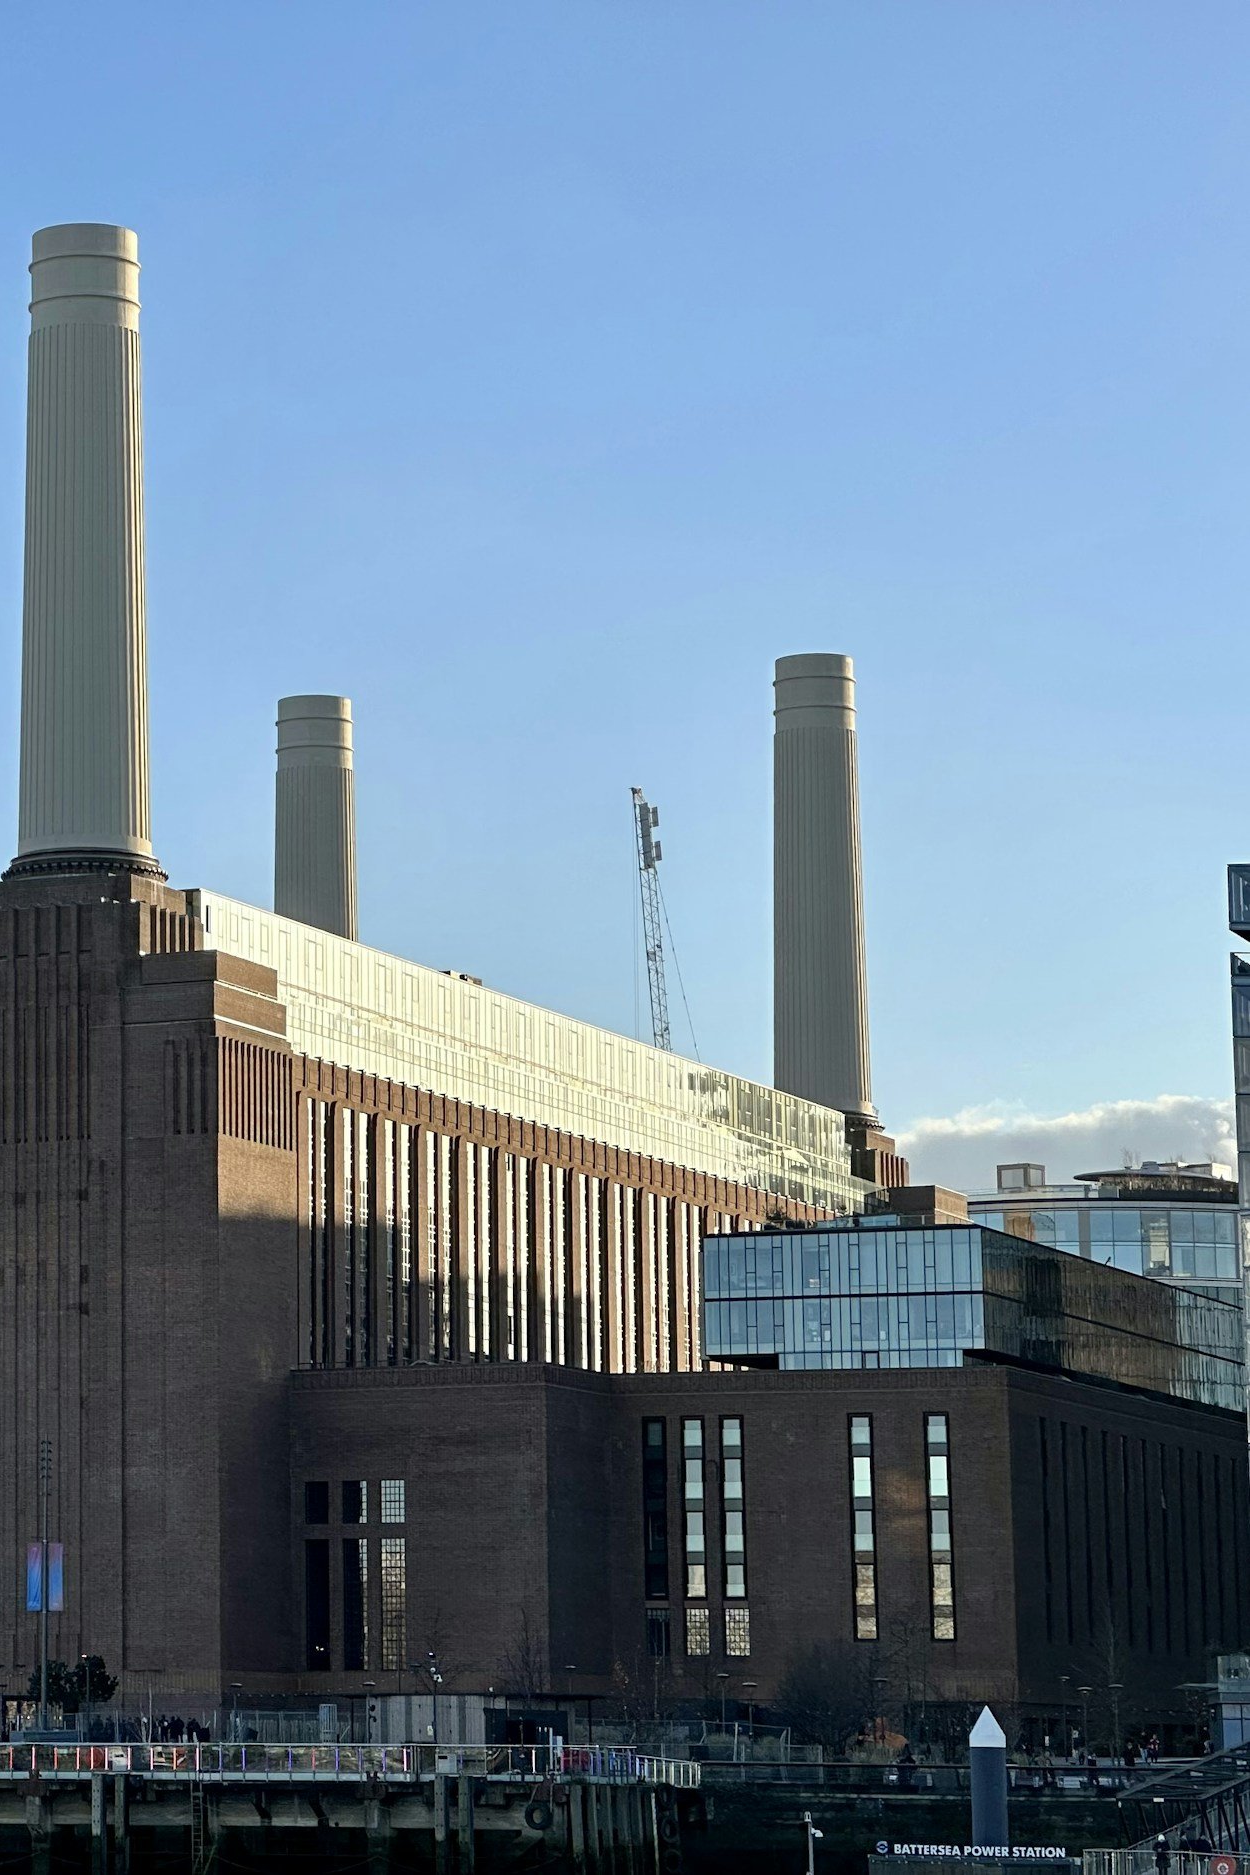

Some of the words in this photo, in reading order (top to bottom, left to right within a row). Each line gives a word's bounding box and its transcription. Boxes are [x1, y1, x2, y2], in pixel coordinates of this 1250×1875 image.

[893, 1843, 961, 1856] BATTERSEA
[963, 1845, 1009, 1857] POWER
[1012, 1846, 1066, 1858] STATION
